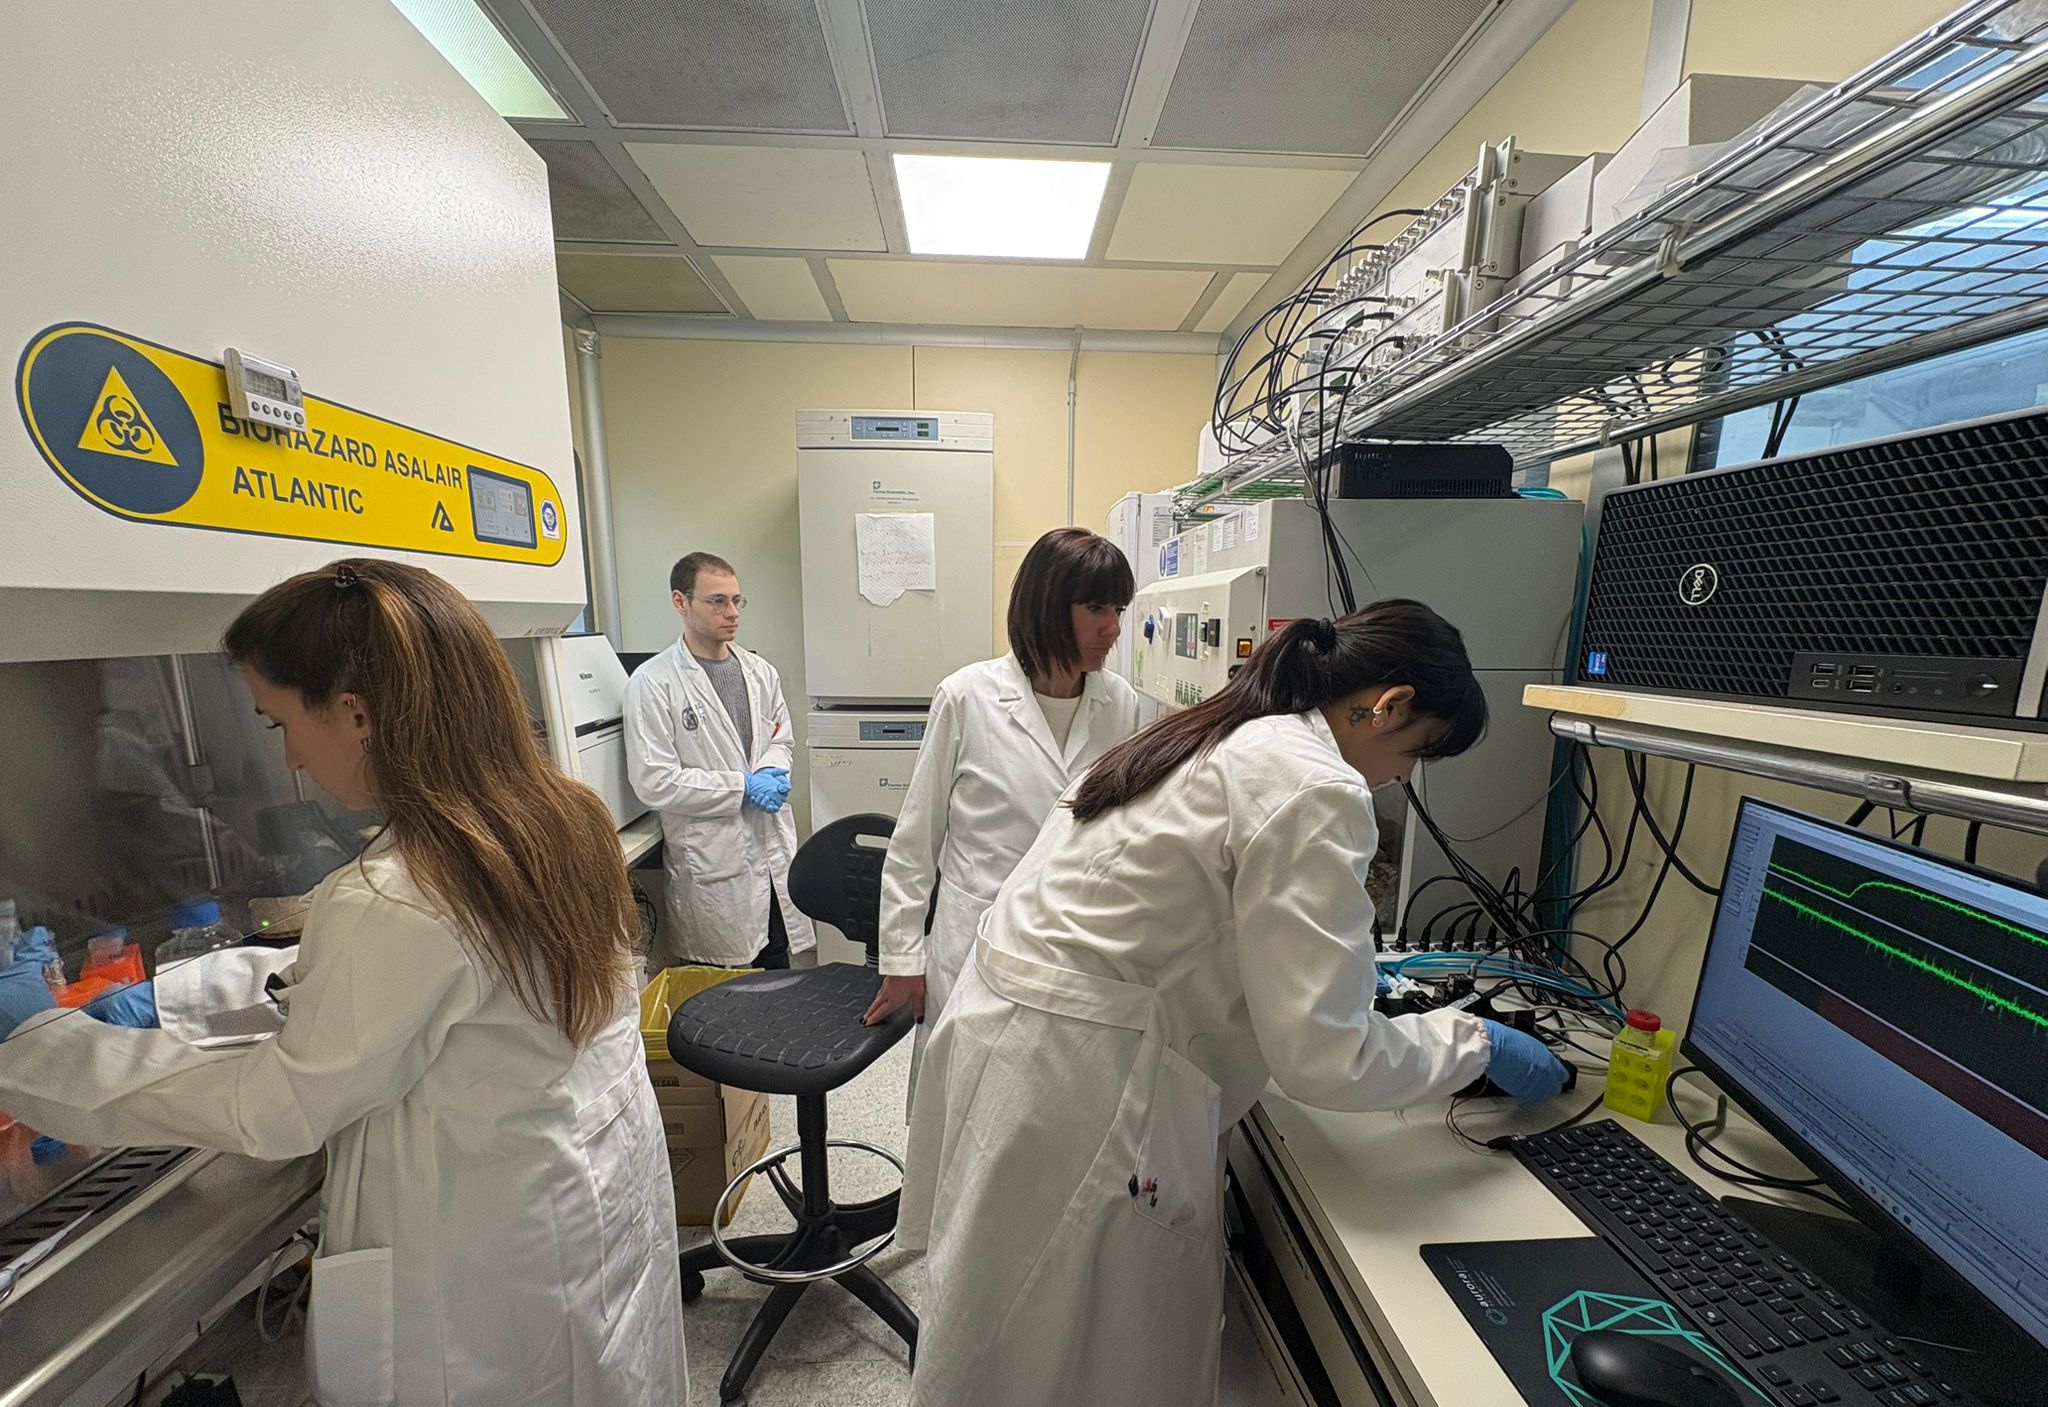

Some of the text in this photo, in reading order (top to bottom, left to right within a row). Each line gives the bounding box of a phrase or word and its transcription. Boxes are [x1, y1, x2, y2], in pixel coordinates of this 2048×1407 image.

[217, 401, 377, 468] BIOHAZARD
[384, 449, 463, 490] ASALAIR
[232, 466, 364, 515] ATLANTIC
[1691, 569, 1705, 601] DELL
[1459, 1273, 1489, 1307] aurora
